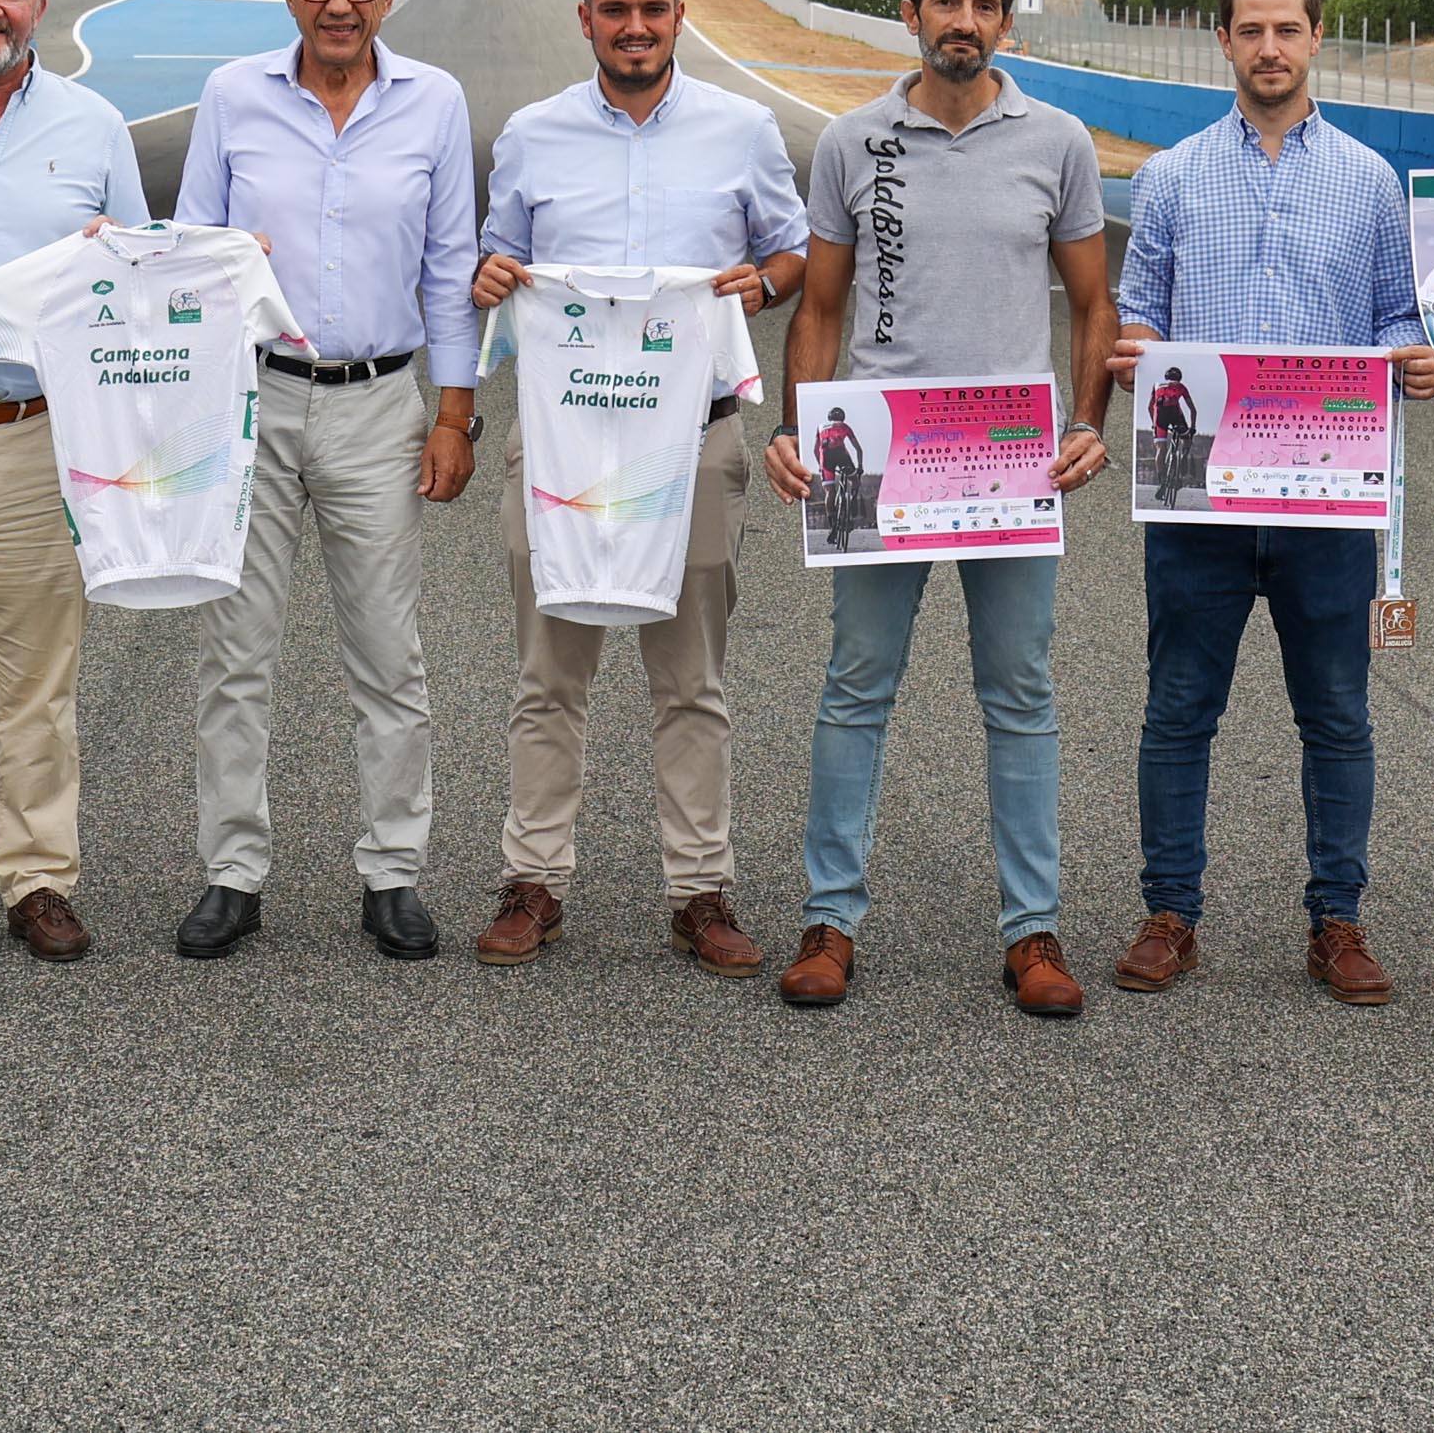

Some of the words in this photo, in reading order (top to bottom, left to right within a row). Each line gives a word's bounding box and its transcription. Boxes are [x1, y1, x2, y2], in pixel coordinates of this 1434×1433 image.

[90, 346, 190, 365] Campeona
[1257, 358, 1265, 368] V
[1281, 358, 1368, 370] TROFEO
[98, 367, 191, 386] Andalucía
[570, 367, 660, 390] Campeón
[560, 389, 658, 410] Andalucía
[919, 391, 927, 401] V
[943, 387, 1031, 401] TROFEO
[1312, 414, 1325, 422] DE
[1333, 415, 1377, 423] AGOSTO
[1232, 422, 1290, 430] CIRCUITO
[1298, 423, 1311, 431] DE
[1318, 424, 1385, 433] VELOCIDAD
[979, 444, 992, 452] DE
[1000, 442, 1045, 451] AGOSTO
[899, 456, 958, 465] CIRCUITO
[966, 454, 979, 462] DE
[986, 451, 1053, 461] VELOCIDAD
[914, 466, 946, 474] JEREZ
[1005, 461, 1039, 470] NIETO
[233, 482, 249, 532] CICLISMO
